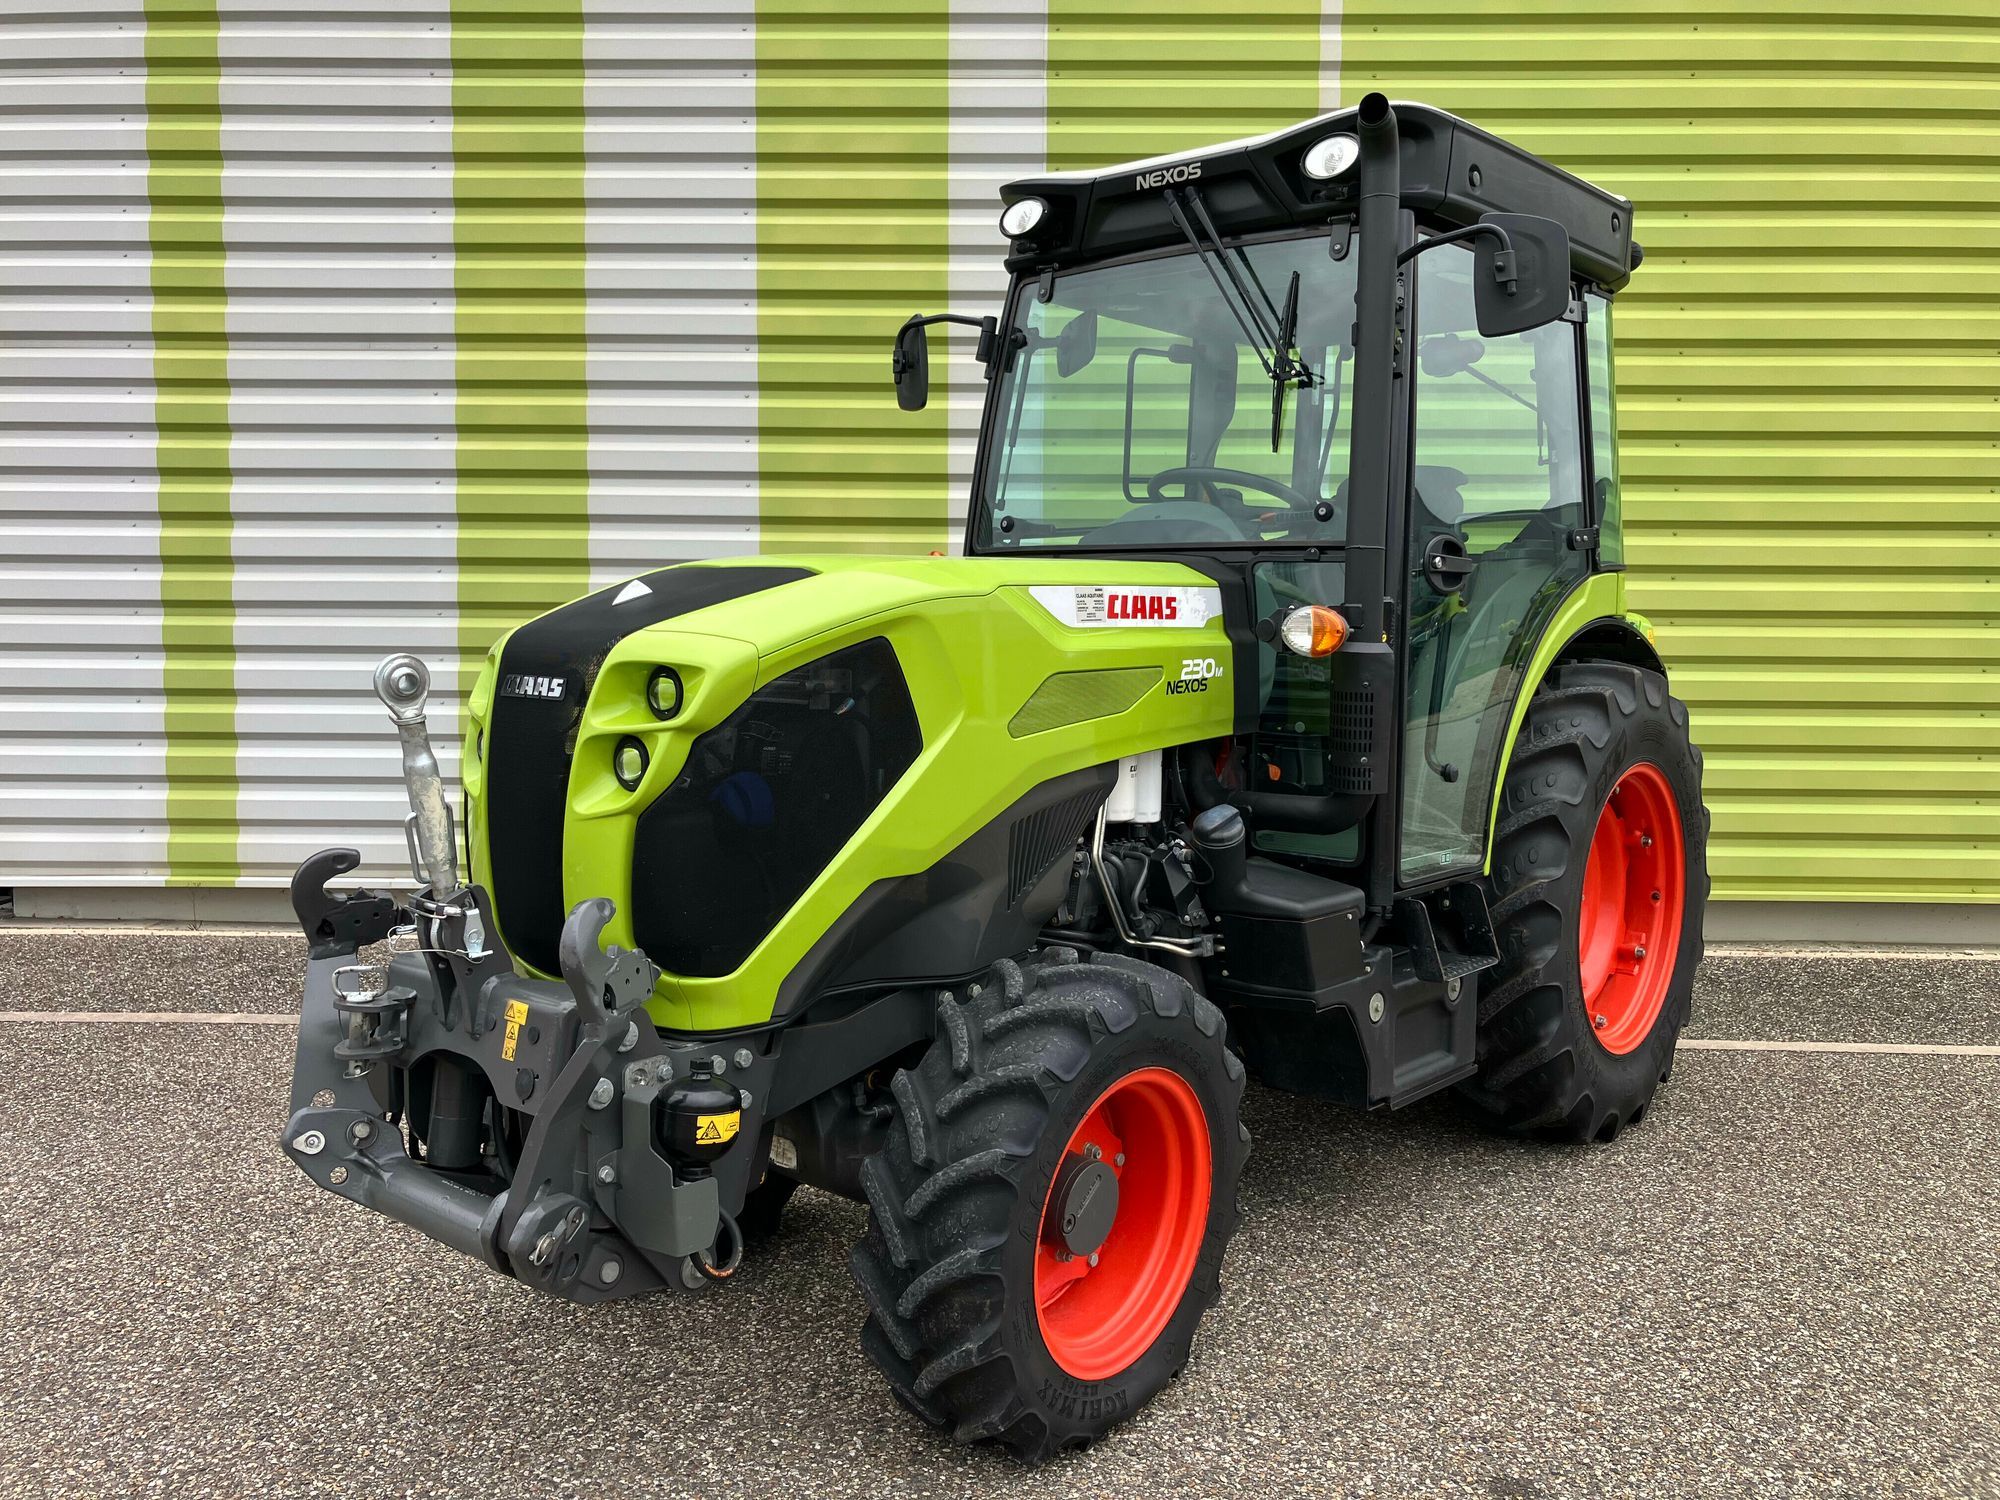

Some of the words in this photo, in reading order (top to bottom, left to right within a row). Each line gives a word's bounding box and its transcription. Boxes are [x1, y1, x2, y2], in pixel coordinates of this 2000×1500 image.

[1136, 162, 1202, 191] NEXOS
[1107, 594, 1177, 620] CLAAS
[1165, 678, 1208, 696] NEXOS
